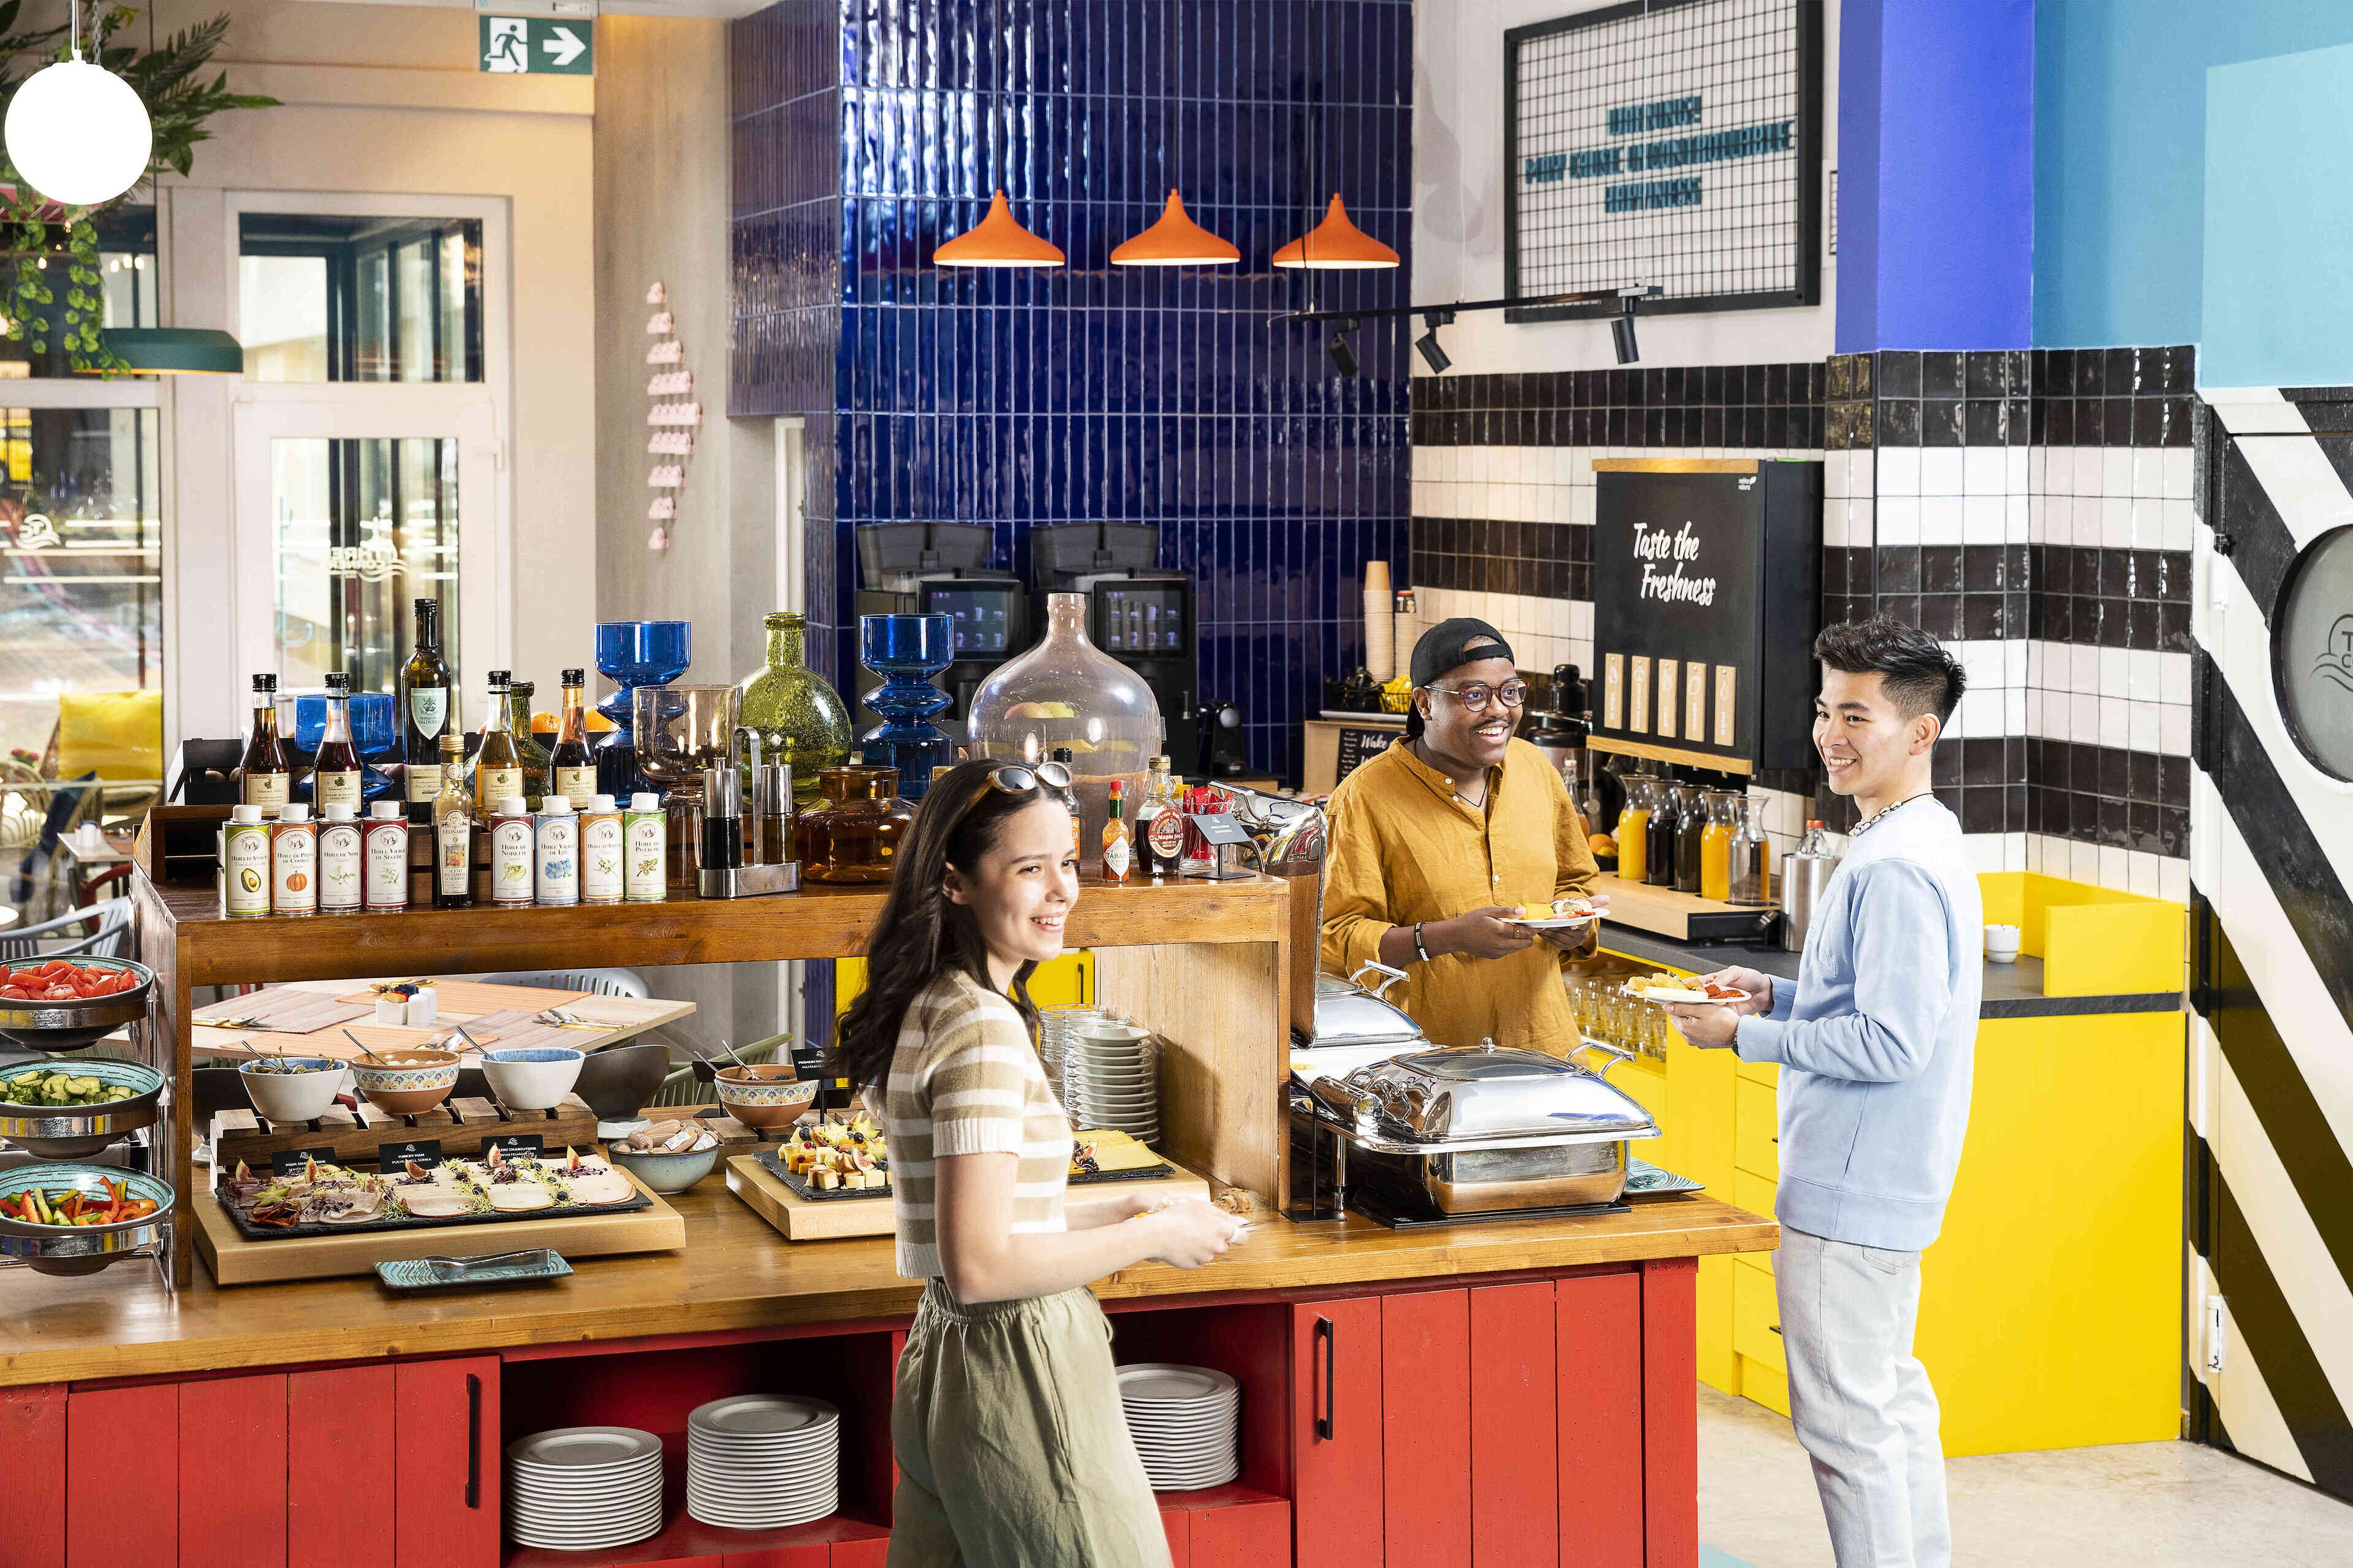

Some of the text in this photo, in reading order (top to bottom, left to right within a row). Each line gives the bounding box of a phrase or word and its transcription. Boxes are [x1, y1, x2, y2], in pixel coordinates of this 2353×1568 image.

[1633, 521, 1700, 561] Taste the
[1640, 561, 1716, 607] Freshness
